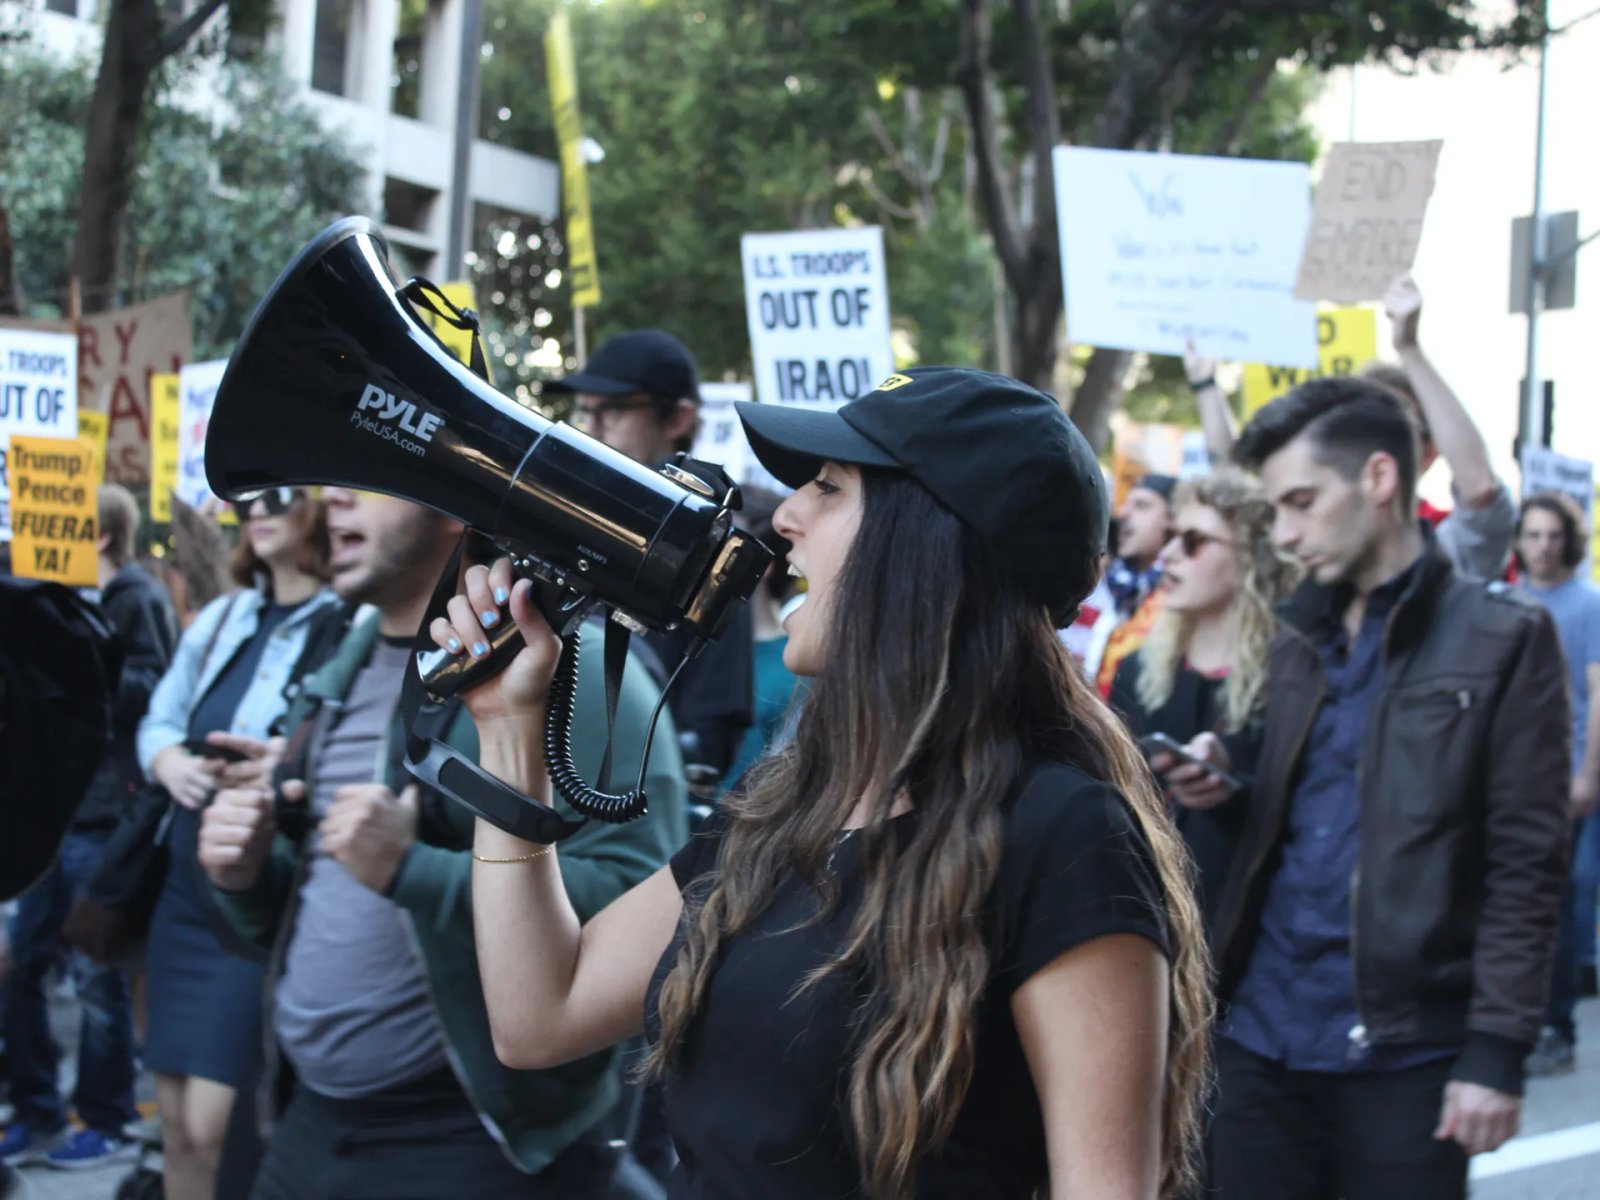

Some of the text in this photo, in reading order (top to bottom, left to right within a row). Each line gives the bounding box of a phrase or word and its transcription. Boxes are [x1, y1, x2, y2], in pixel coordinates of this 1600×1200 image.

[790, 250, 871, 277] TROOPS
[760, 286, 869, 330] OUT OF
[0, 384, 27, 420] UT
[36, 387, 65, 425] OF
[350, 410, 426, 457] PyleUSA.com
[17, 475, 86, 506] Pence
